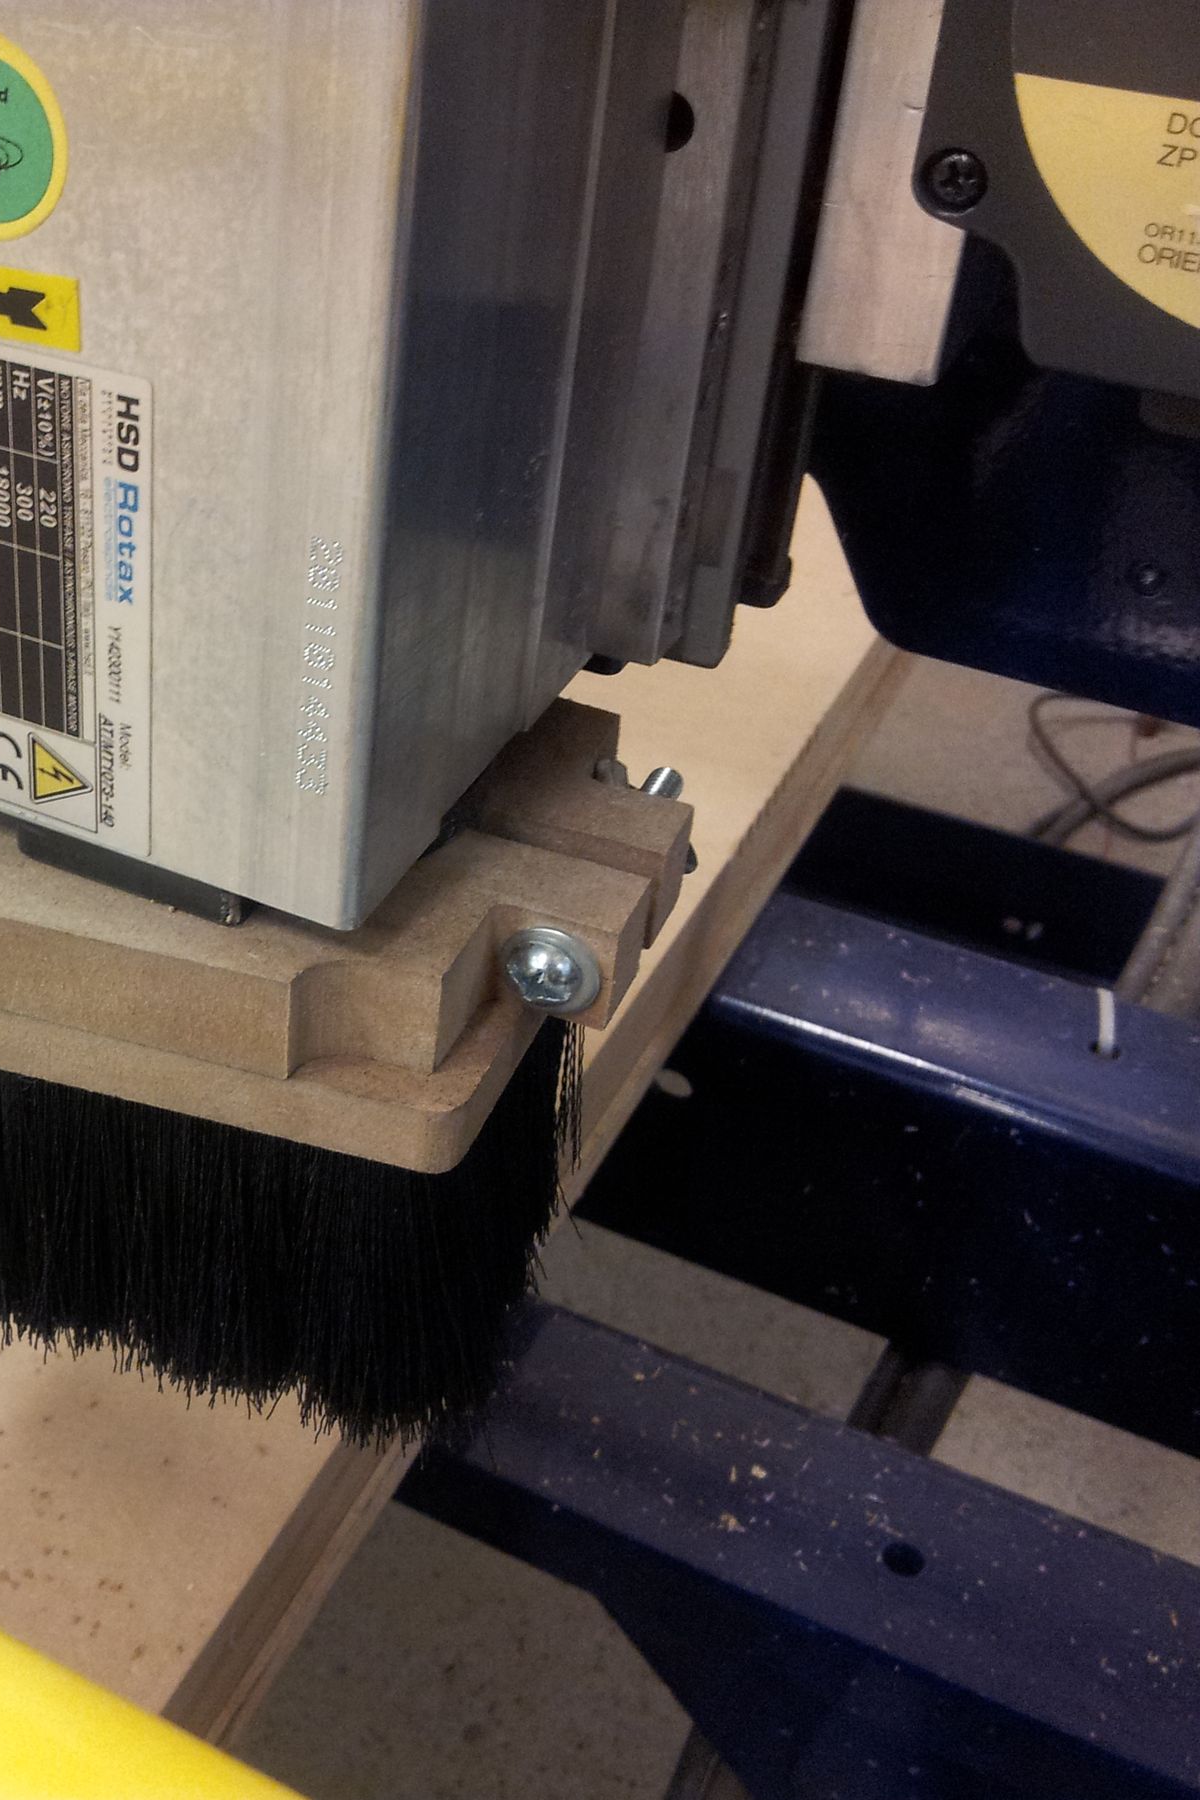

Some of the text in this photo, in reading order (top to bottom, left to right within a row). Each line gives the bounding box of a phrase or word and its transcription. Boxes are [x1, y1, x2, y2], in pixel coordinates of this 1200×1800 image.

[1138, 244, 1200, 273] ORIE
[12, 370, 33, 521] Hz 300
[39, 488, 56, 528] 220
[117, 396, 139, 606] HSD Rotax
